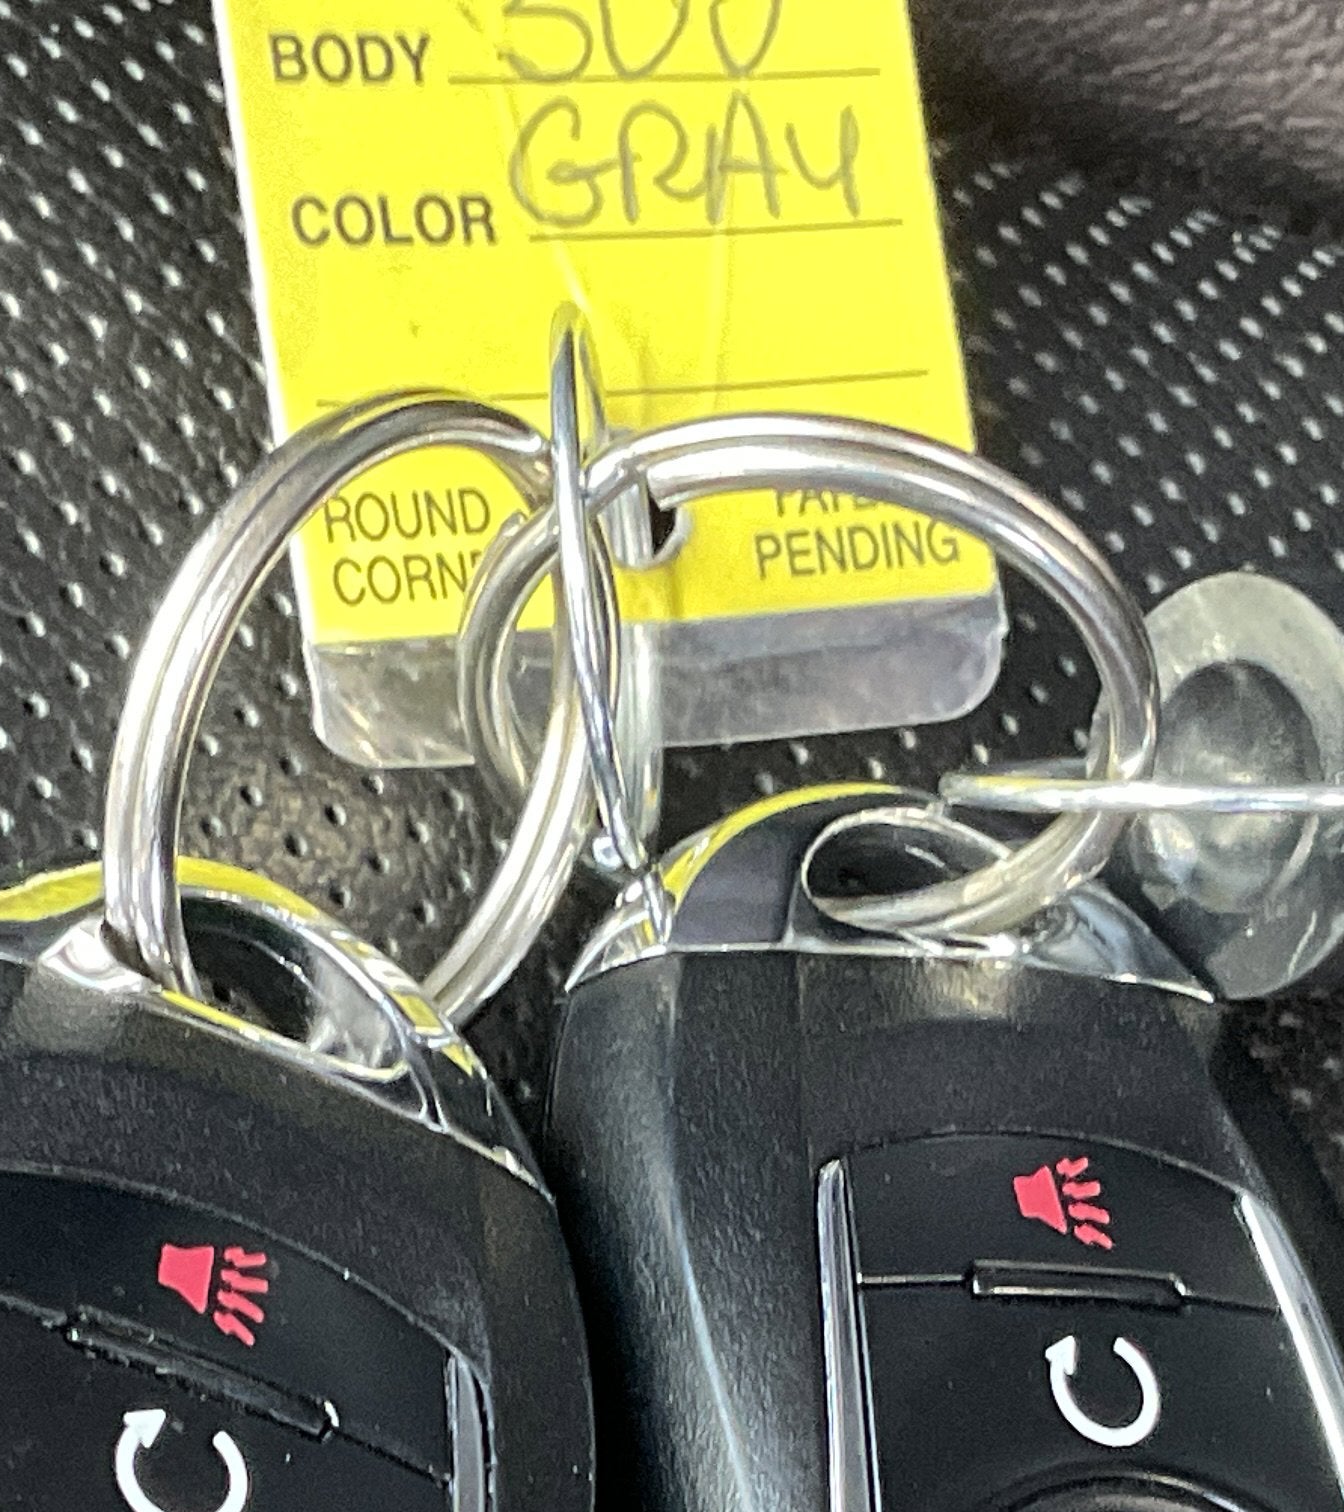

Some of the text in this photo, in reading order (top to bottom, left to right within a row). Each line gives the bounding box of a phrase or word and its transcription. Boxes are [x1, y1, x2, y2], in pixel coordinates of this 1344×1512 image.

[268, 31, 431, 86] BODY
[508, 89, 861, 228] GRAY
[291, 193, 497, 247] COLOR
[324, 486, 491, 543] ROUND
[755, 517, 960, 581] PENDING
[333, 550, 483, 607] CORN
